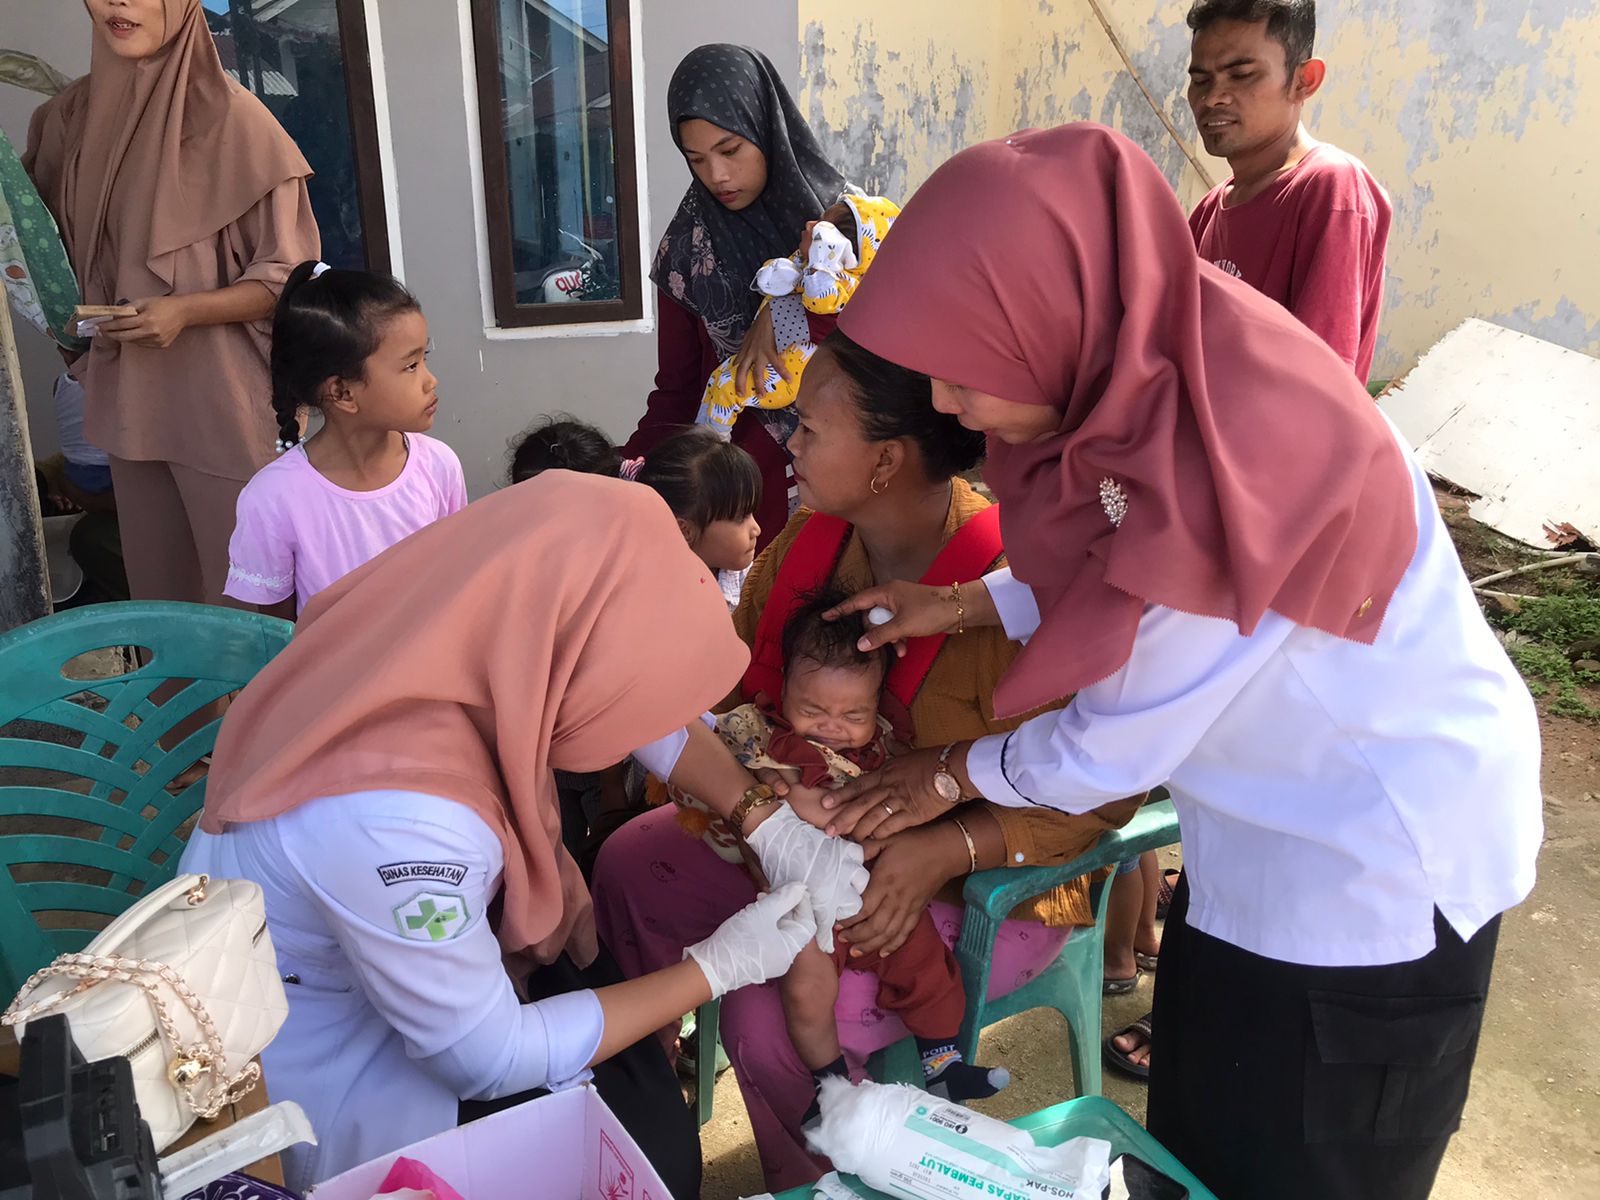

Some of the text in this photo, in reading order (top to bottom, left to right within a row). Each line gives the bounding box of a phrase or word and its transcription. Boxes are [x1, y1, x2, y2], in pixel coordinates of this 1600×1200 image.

[382, 866, 461, 881] DINAS KESEHATAN
[919, 1156, 984, 1189] PEMBALUT
[1026, 1179, 1074, 1199] HOS-PAK
